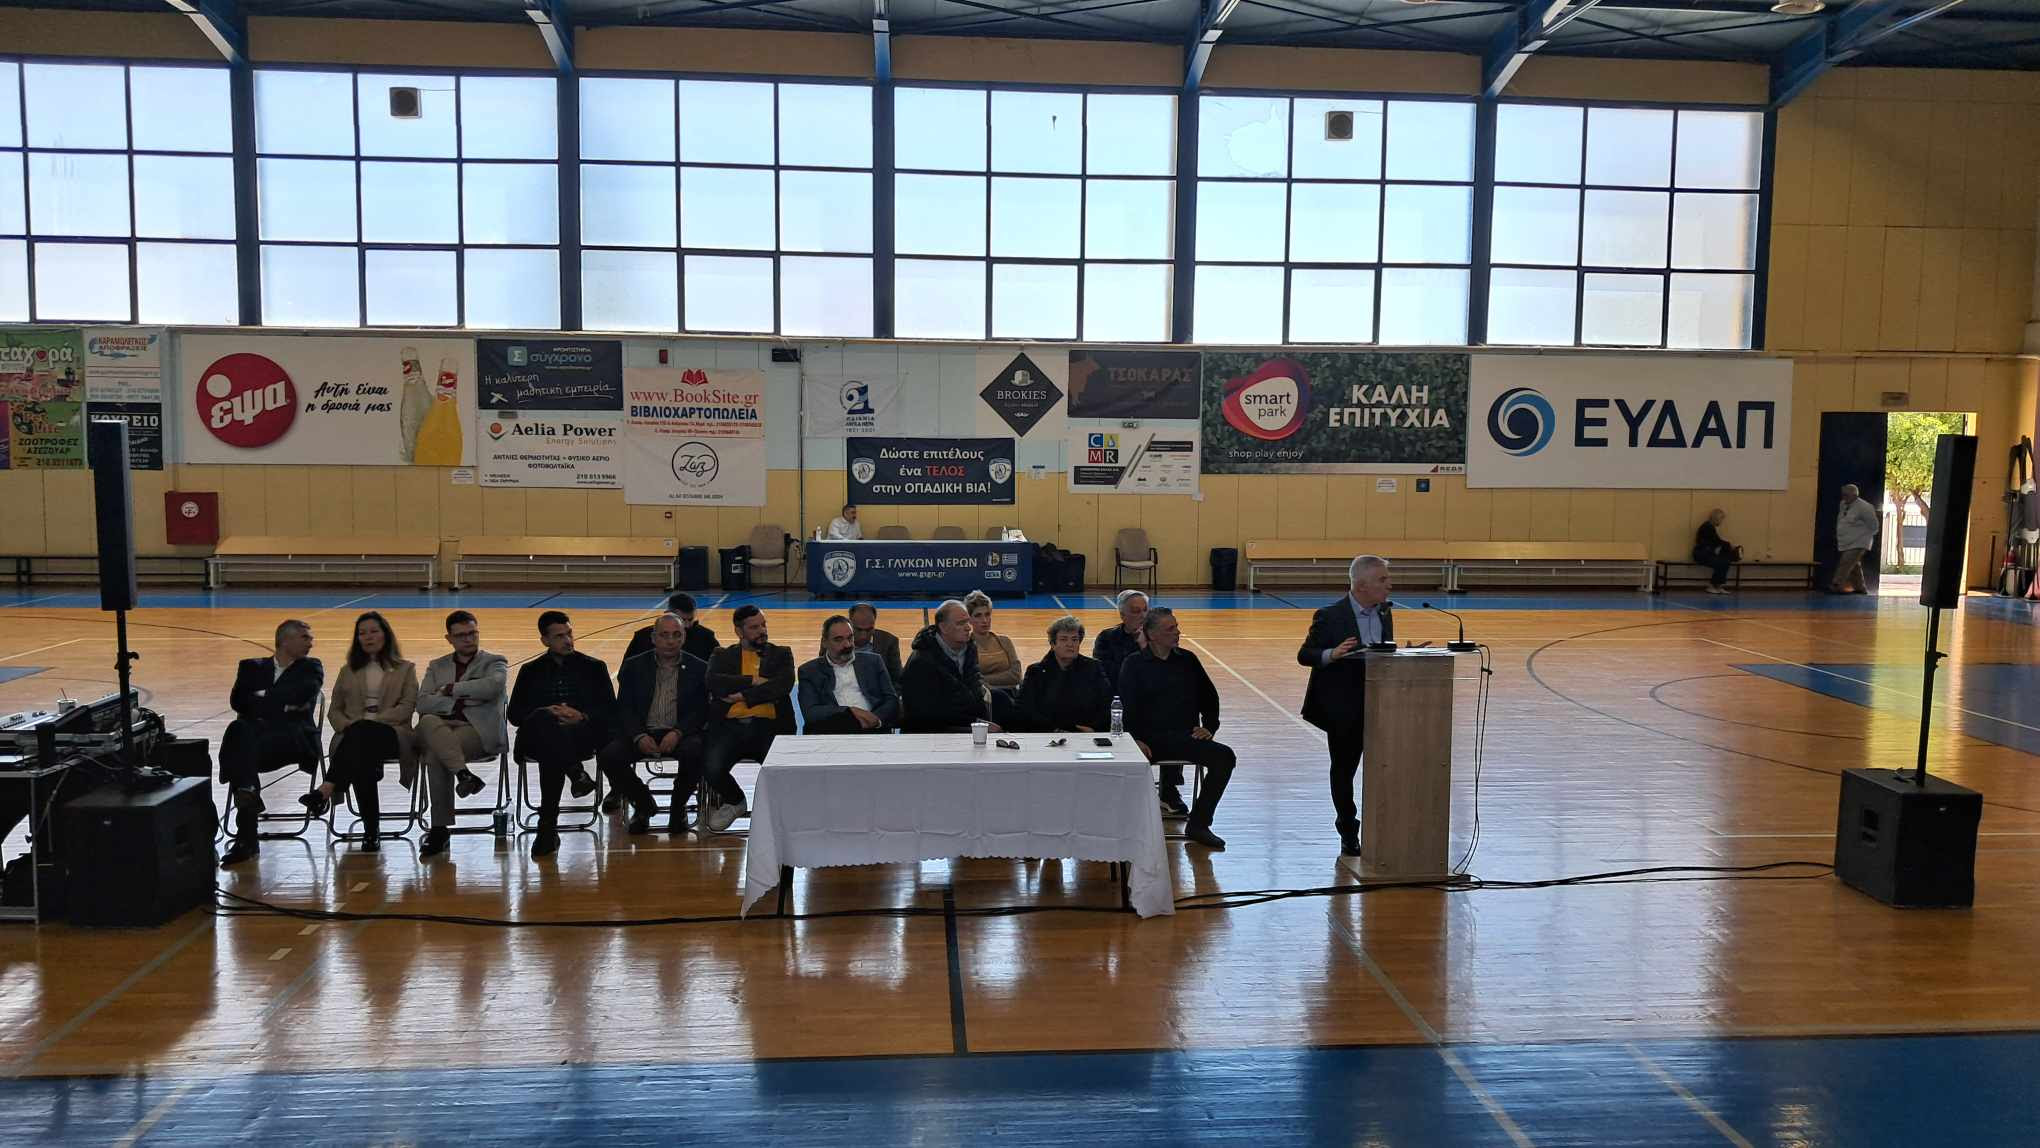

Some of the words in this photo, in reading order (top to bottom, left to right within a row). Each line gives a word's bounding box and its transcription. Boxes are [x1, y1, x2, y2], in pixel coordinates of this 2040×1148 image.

[530, 352, 592, 364] σύγχρονο
[1108, 367, 1193, 383] ΤΣΟΚΑΡΑΣ
[314, 381, 350, 399] Αυτή
[997, 391, 1047, 400] BROKIES
[1351, 384, 1429, 405] ΚΑΛΗ
[630, 388, 760, 407] www.BookSite.gr
[1244, 392, 1291, 405] smart
[321, 400, 361, 412] δροσιά
[365, 401, 393, 414] μας
[630, 405, 758, 420] ΒΙΒΛΙΟΧΑΡΤΟΠΩΛΕΙΑ
[1258, 405, 1287, 420] park
[1328, 407, 1450, 428] ΕΠΙΤΥΧΙΑ
[1574, 398, 1775, 449] ΕΥΔΑΠ
[511, 423, 556, 436] Aelia
[562, 424, 616, 436] Power
[546, 438, 575, 446] Energy
[880, 448, 920, 459] Δώστε
[923, 448, 984, 461] επιτέλους
[1228, 448, 1253, 459] shop
[1255, 448, 1276, 459] play
[1277, 448, 1304, 459] enjoy
[900, 465, 922, 476] ένα
[926, 465, 966, 476] ΤΕΛΟΣ
[872, 485, 901, 495] στην
[905, 483, 962, 493] ΟΠΑΔΙΚΗ
[966, 482, 991, 493] ΒΙΑ!
[865, 558, 884, 569] Γ.Σ.
[888, 557, 933, 568] ΓΛΥΚΩΝ
[937, 557, 977, 568] ΝΕΡΩΝ
